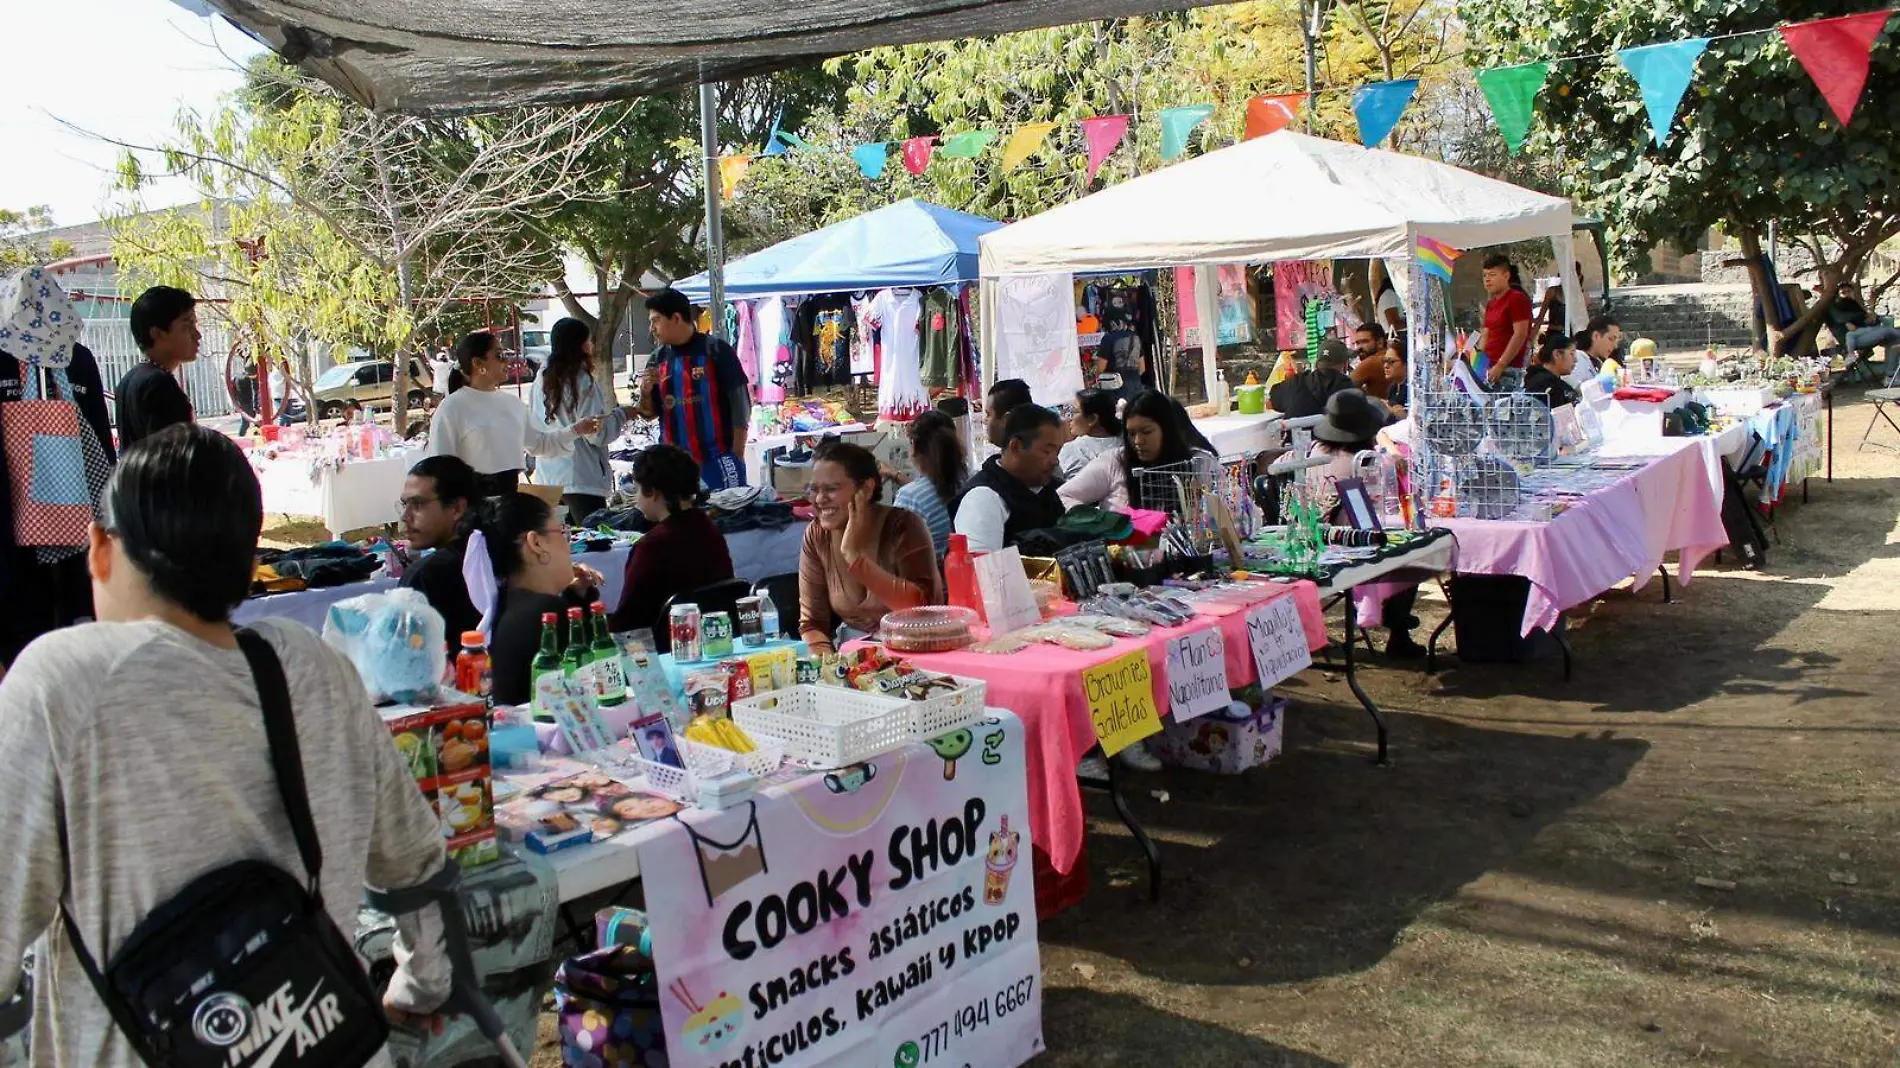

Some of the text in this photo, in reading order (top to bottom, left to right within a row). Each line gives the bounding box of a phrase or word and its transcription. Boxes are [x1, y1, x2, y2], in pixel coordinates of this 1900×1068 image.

[722, 797, 986, 961] COOKY SHOP
[868, 885, 976, 960] asiáticos
[938, 942, 956, 970] y
[294, 992, 345, 1059] AIR
[920, 976, 1034, 1063] 777 494 6667
